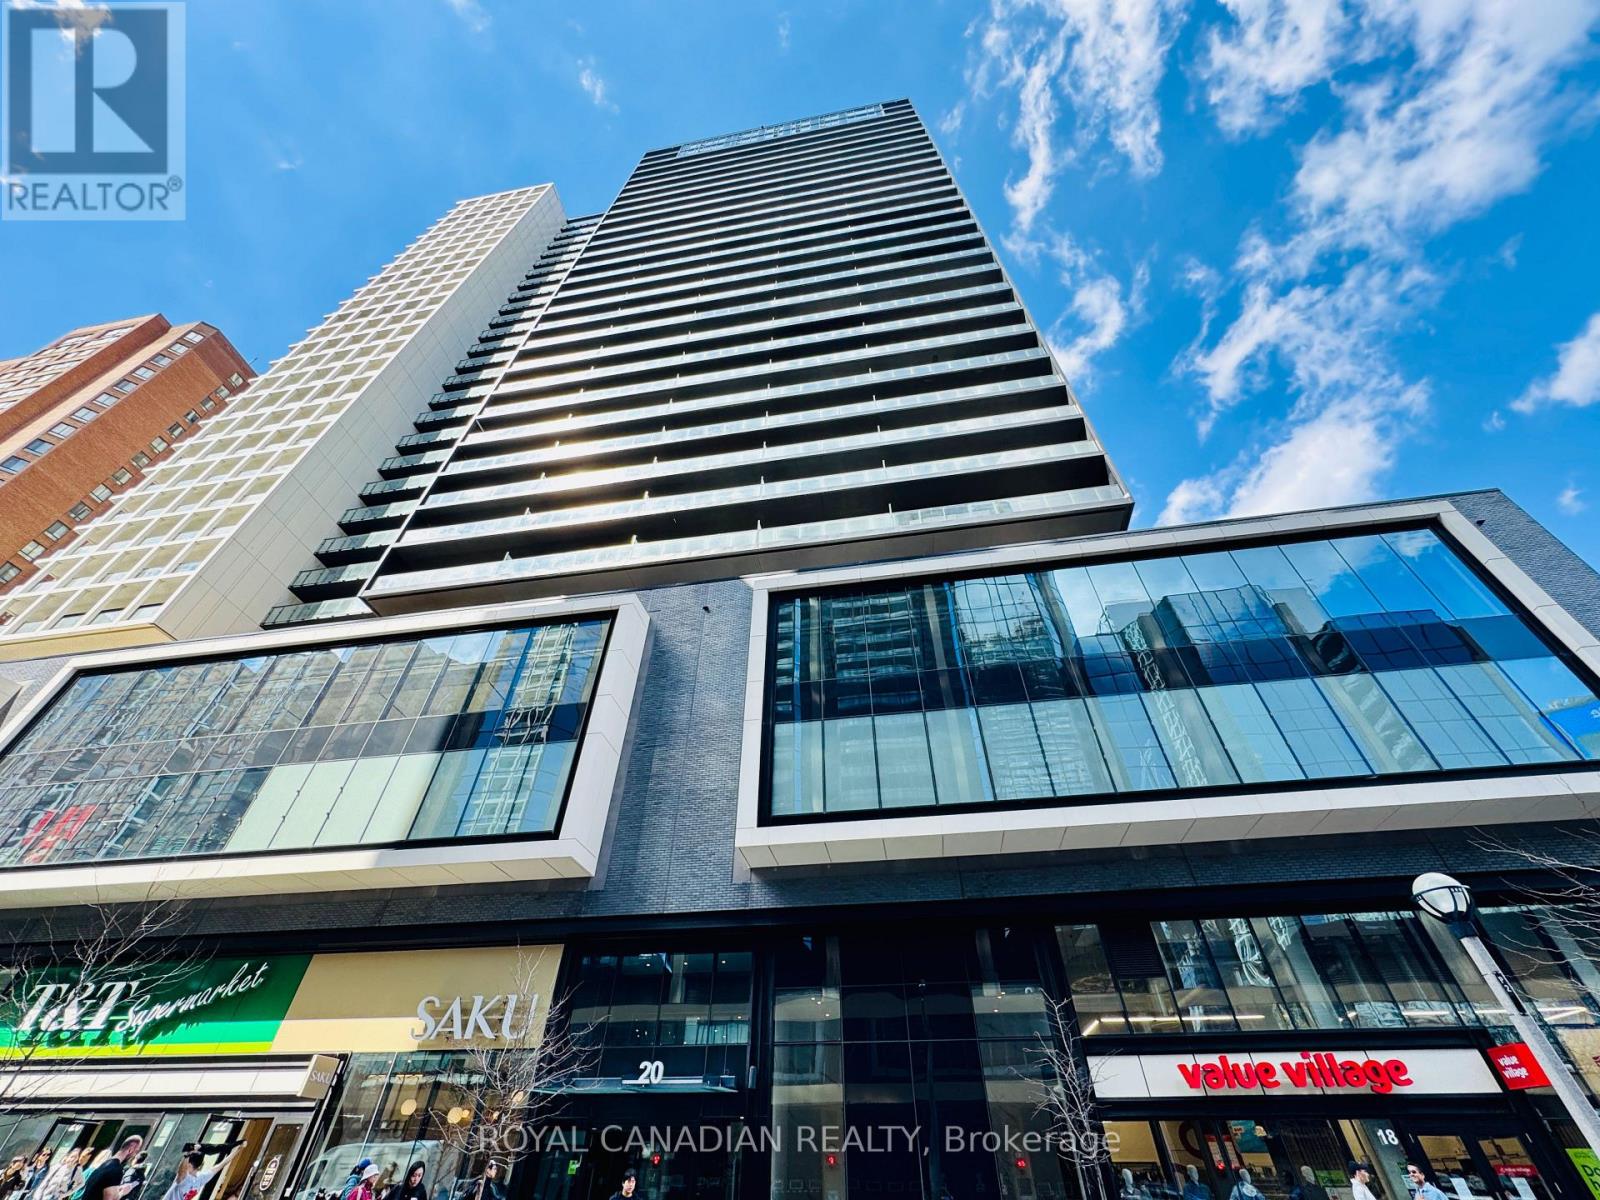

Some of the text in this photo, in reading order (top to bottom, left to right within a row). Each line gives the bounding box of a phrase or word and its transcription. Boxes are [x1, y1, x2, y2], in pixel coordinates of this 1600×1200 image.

[16, 961, 270, 1038] T&T Supermarket
[410, 993, 539, 1041] SAKU
[310, 1070, 332, 1084] SAKU
[637, 1060, 665, 1085] 20
[1178, 1051, 1413, 1094] value village
[1502, 1066, 1529, 1079] village
[1377, 1129, 1399, 1145] 18
